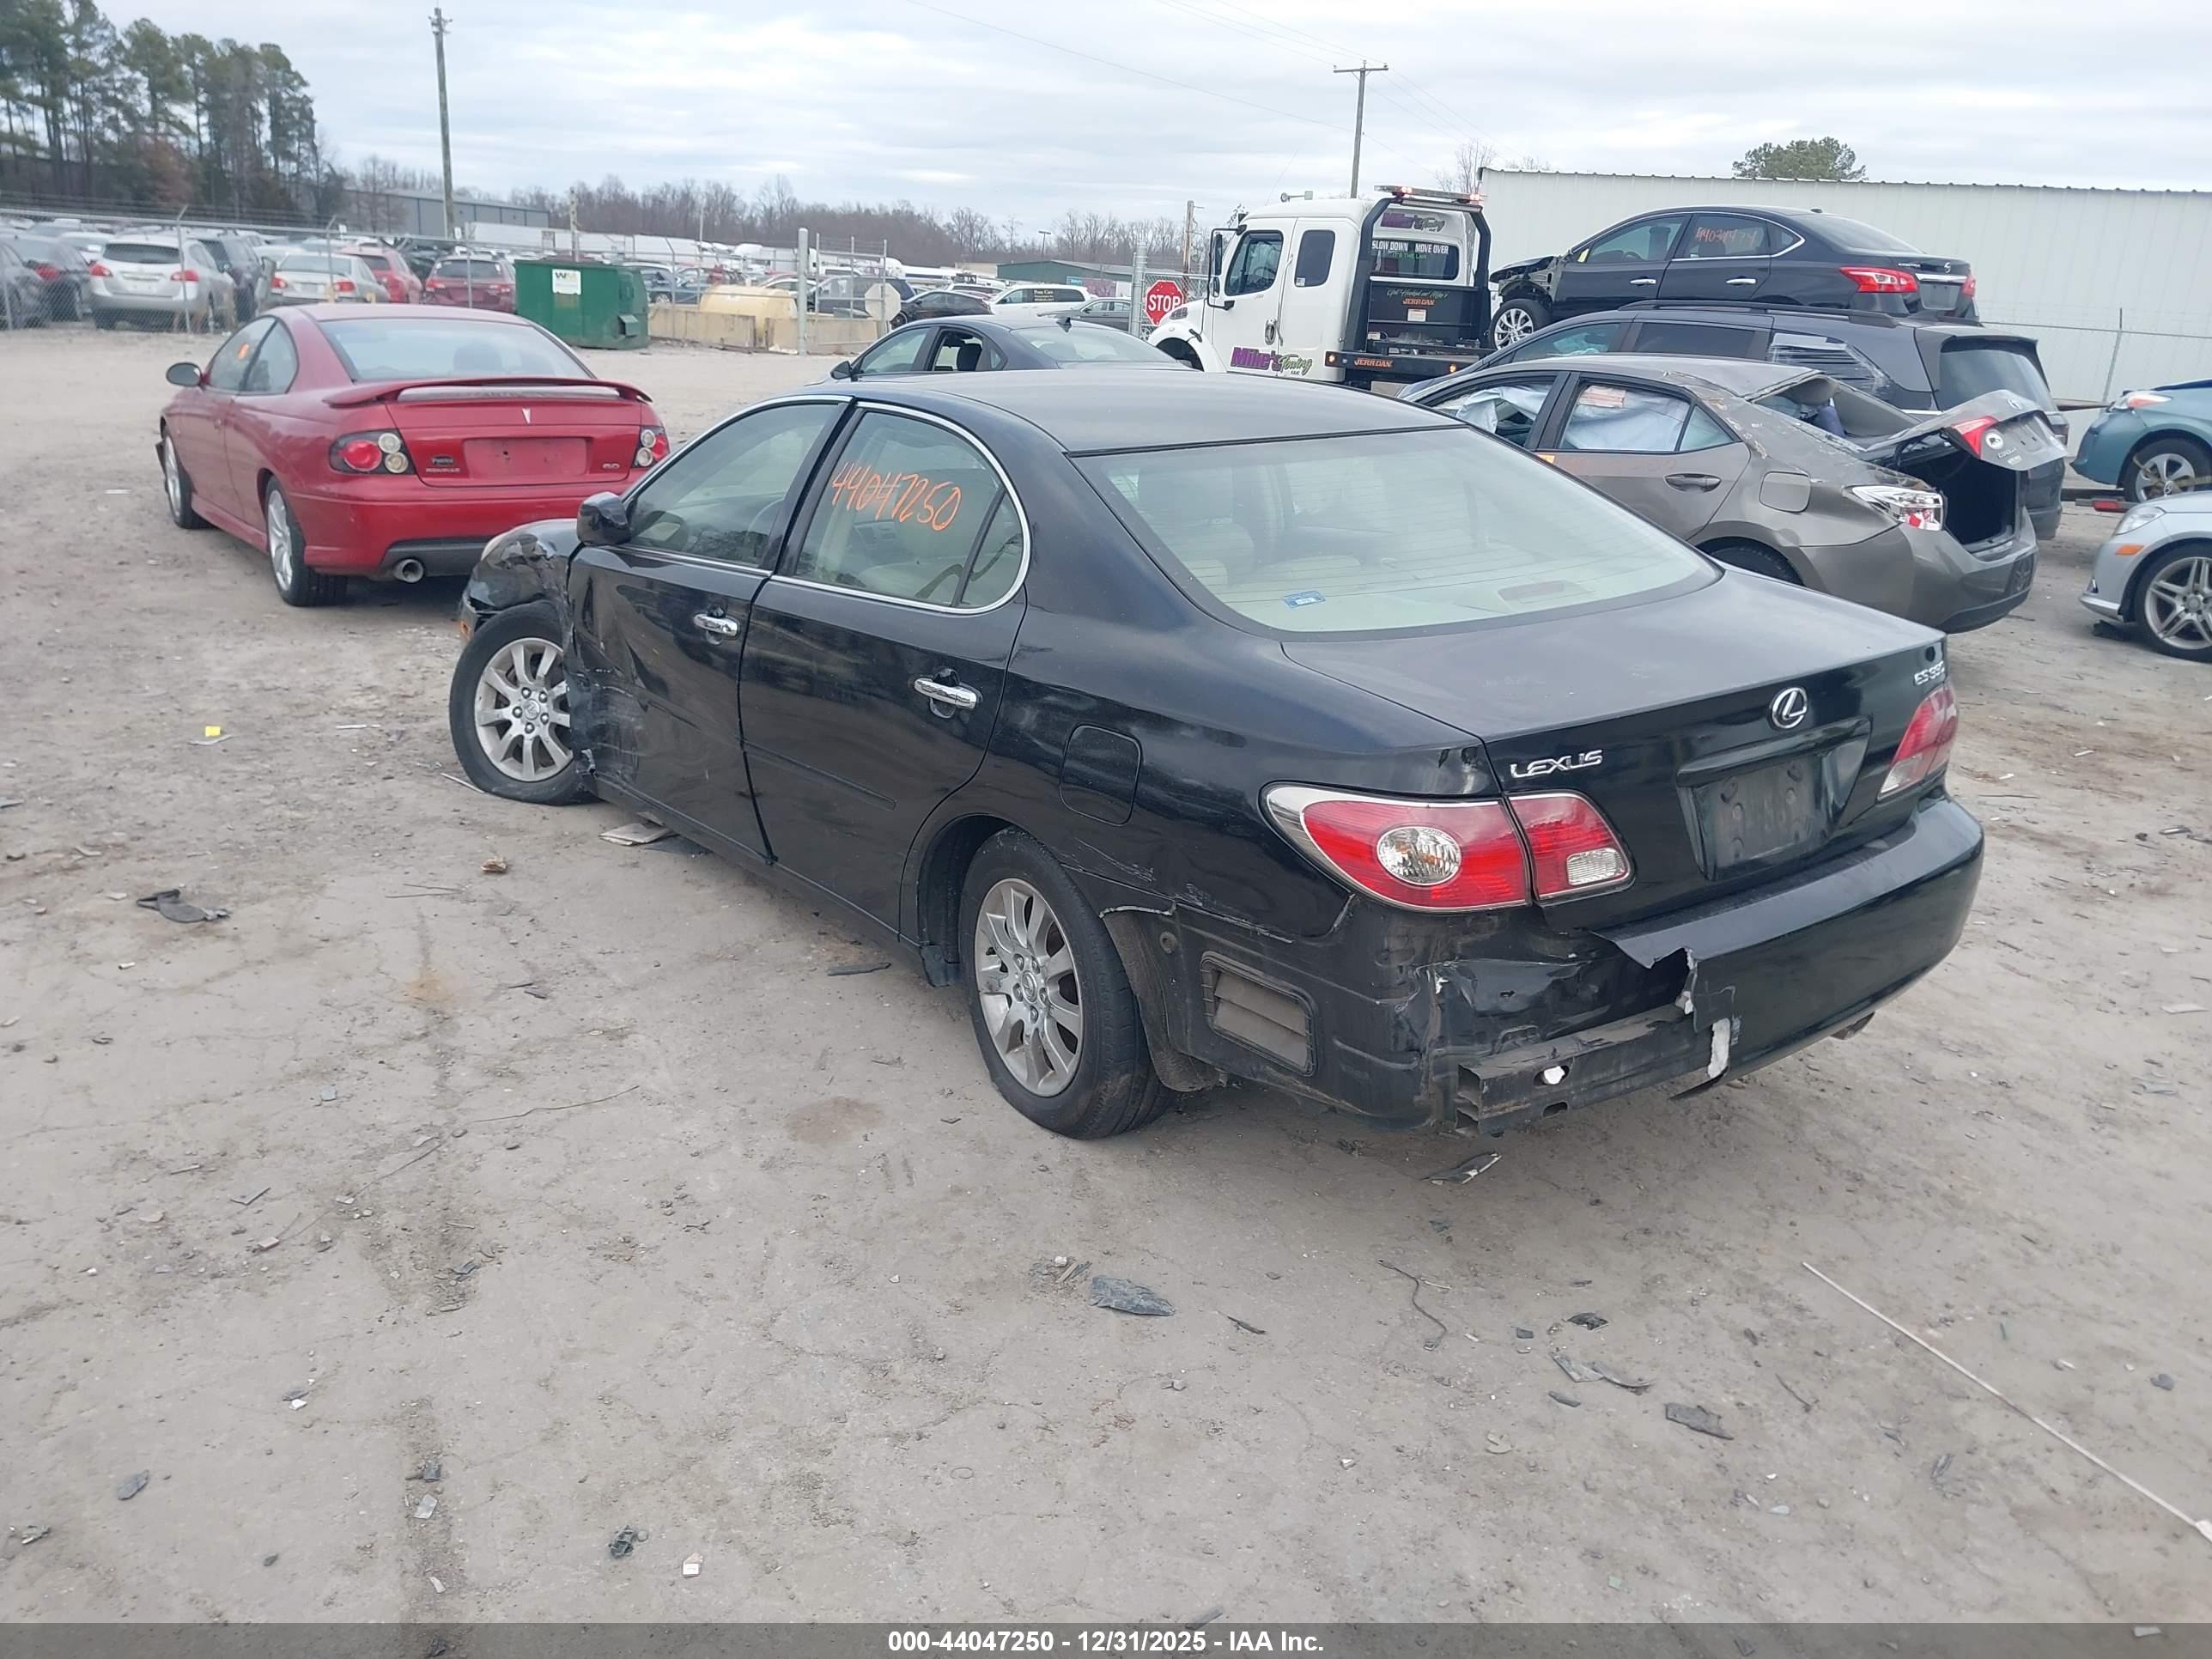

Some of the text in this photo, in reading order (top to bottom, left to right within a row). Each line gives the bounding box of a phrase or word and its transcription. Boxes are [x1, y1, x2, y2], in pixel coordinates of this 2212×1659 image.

[1371, 240, 1449, 255] SLOW DOWN MOVE OVER
[1148, 294, 1182, 313] STOP
[1231, 346, 1313, 376] Mike's Towing
[831, 461, 963, 532] 44047250
[1510, 750, 1603, 778] LEXUS
